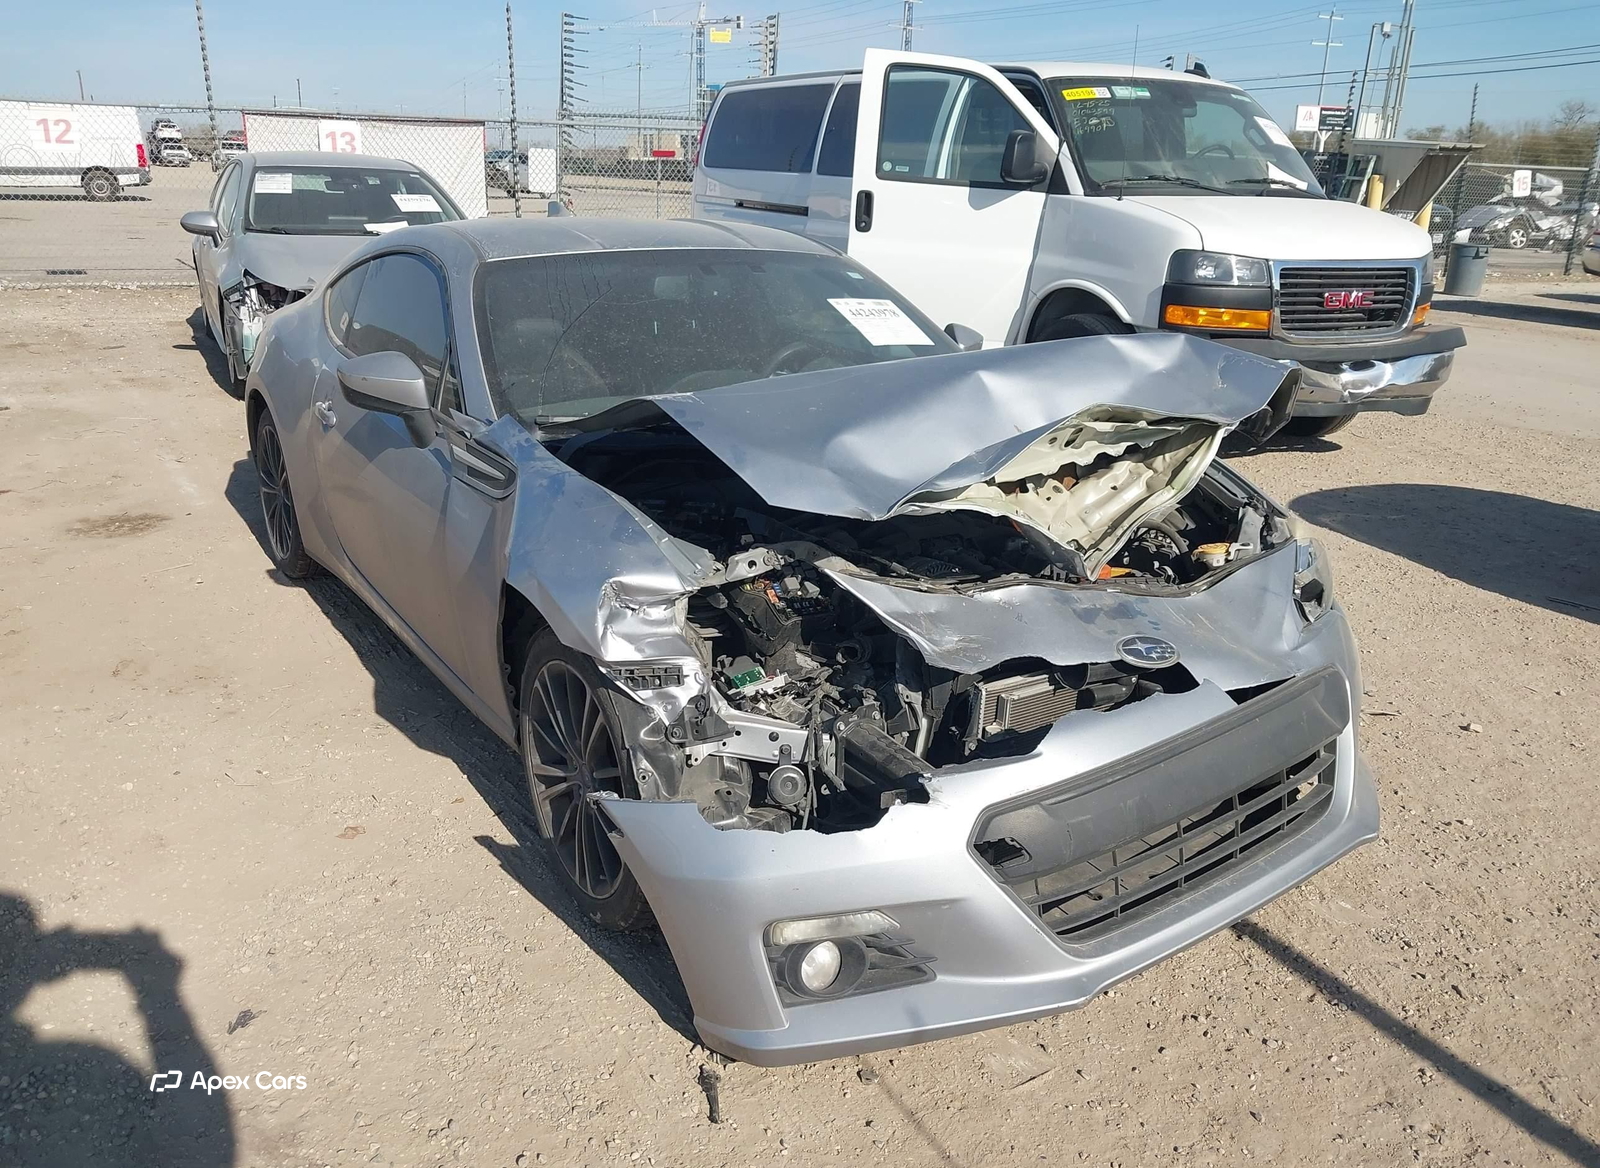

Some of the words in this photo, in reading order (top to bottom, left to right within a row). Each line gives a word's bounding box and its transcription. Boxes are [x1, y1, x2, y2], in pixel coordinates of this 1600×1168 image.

[1066, 89, 1096, 98] 405196
[36, 118, 74, 144] 12
[325, 131, 357, 155] 13
[1516, 176, 1529, 191] 15
[1323, 290, 1375, 309] GMC
[848, 308, 900, 318] 44243978
